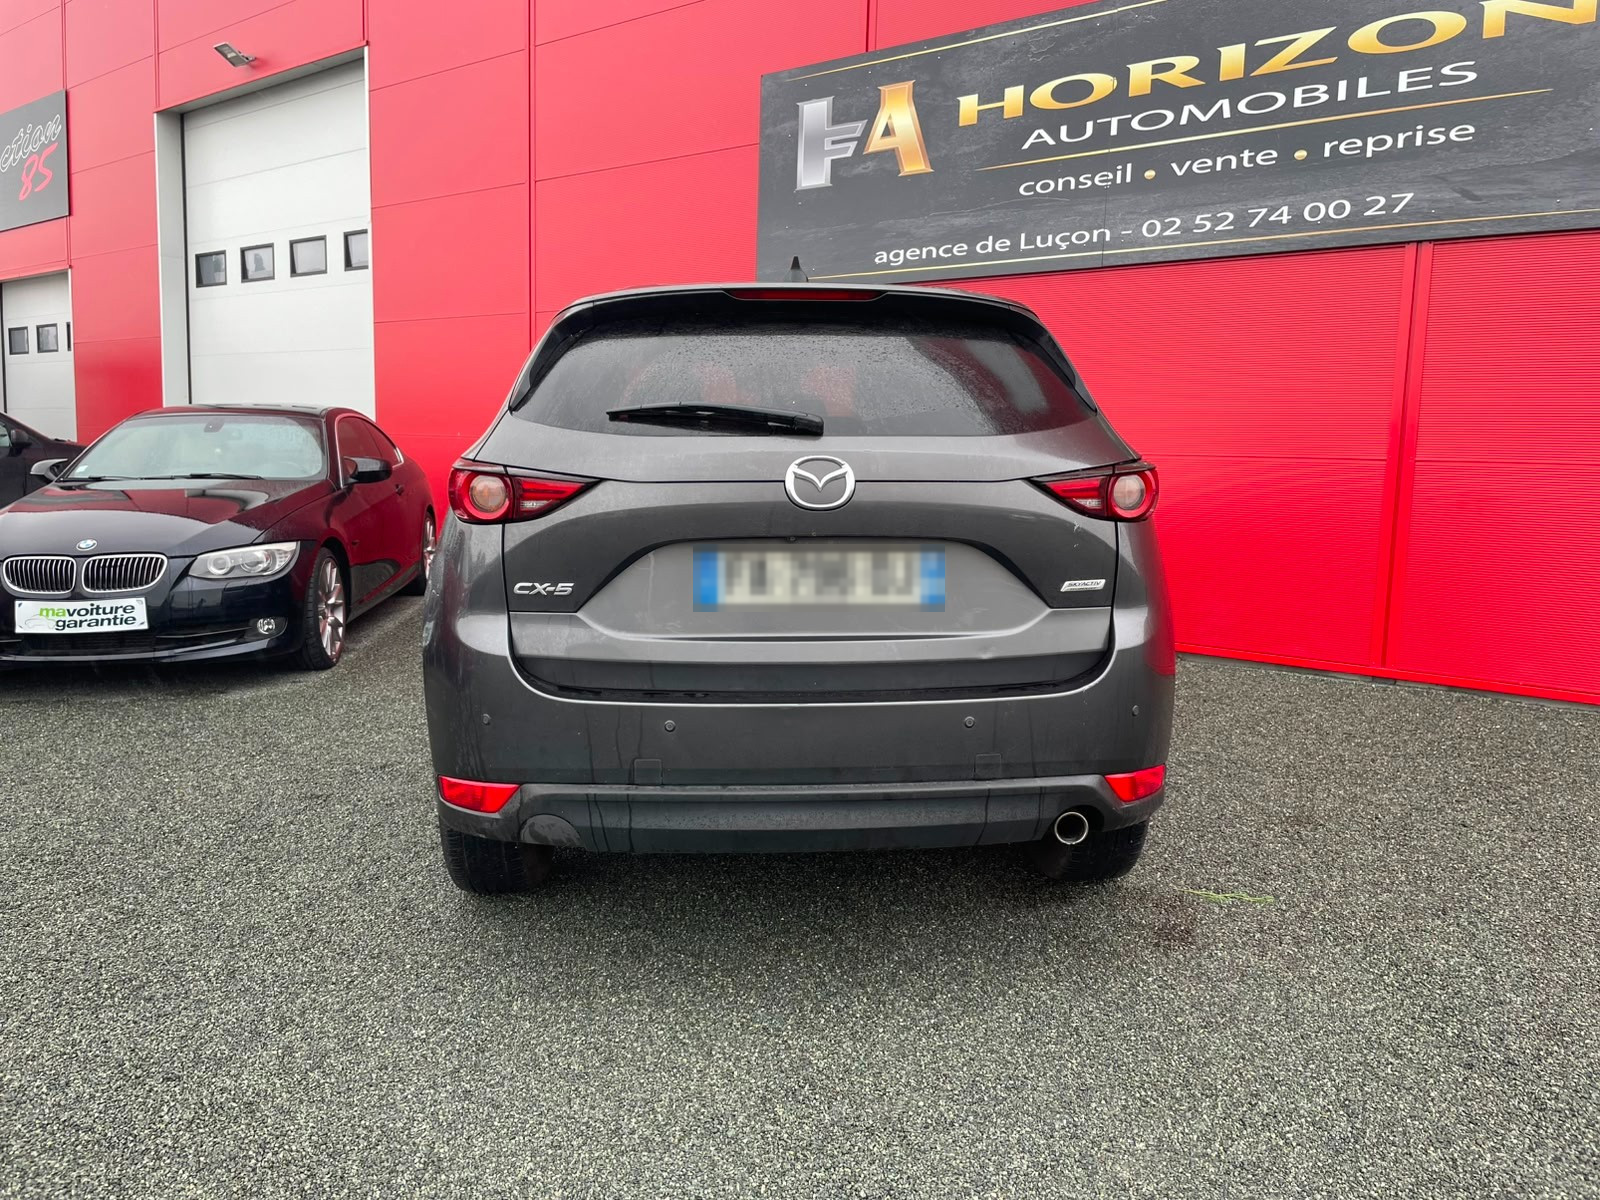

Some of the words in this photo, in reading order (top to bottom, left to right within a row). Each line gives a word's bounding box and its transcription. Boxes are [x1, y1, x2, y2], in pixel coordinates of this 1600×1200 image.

[957, 0, 1597, 126] HORIZON
[1021, 60, 1478, 149] AUTOMOBILES
[19, 142, 58, 200] 85
[1018, 163, 1133, 196] conseil
[1170, 149, 1278, 177] vente
[1322, 124, 1476, 158] reprise
[874, 244, 968, 266] agence
[975, 236, 1011, 254] de
[1019, 228, 1111, 250] Luçon
[1141, 218, 1182, 238] 02
[1192, 211, 1235, 233] 52
[1247, 206, 1293, 228] 74
[1303, 200, 1351, 222] 00
[1363, 192, 1414, 216] 27
[55, 614, 137, 631] garantie
[513, 582, 574, 596] CX-5
